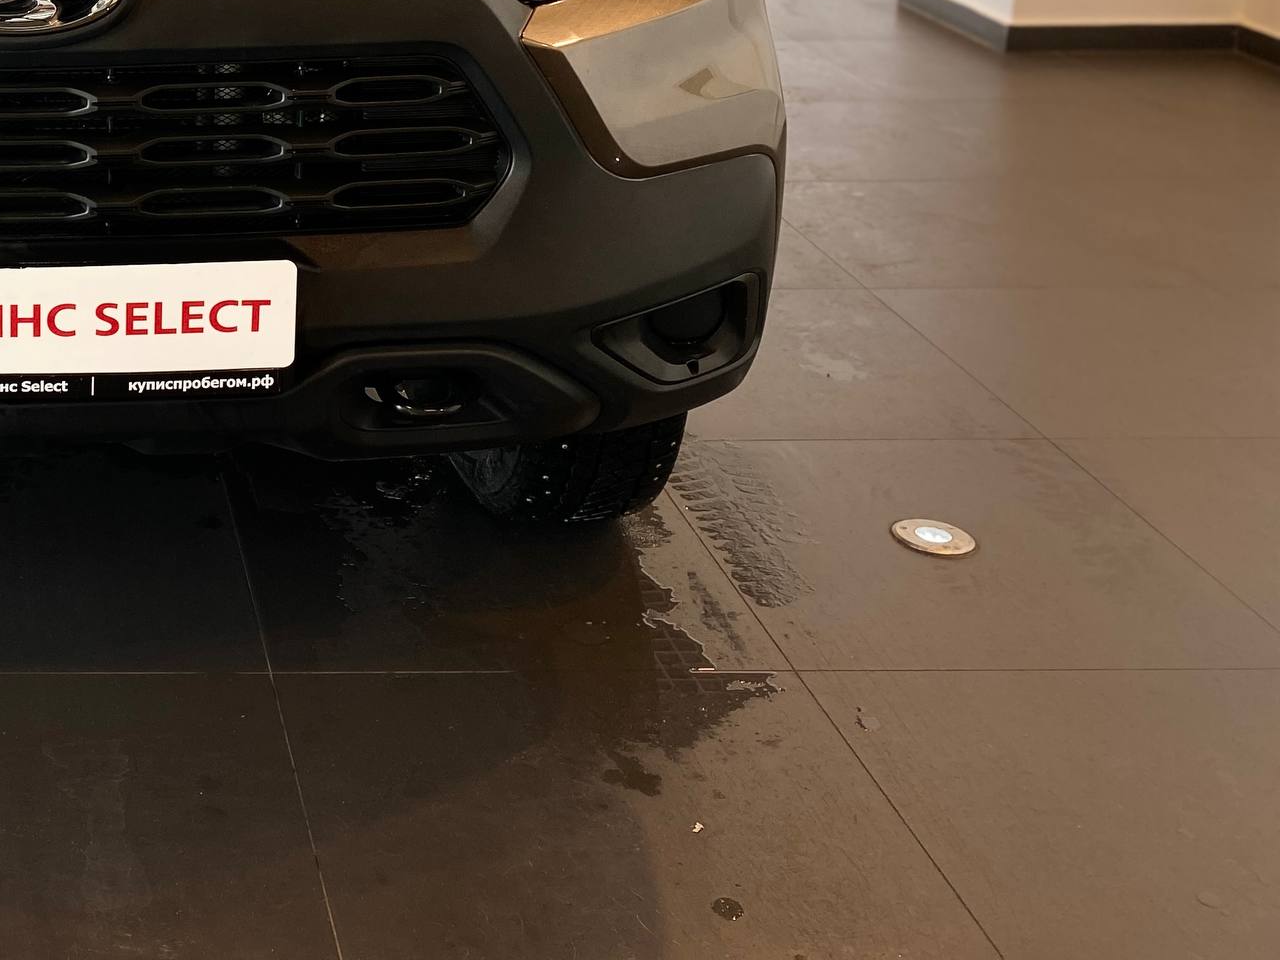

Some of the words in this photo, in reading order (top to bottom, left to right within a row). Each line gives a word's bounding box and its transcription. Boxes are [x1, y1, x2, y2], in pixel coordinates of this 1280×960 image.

[94, 298, 272, 337] SELECT
[21, 379, 69, 393] Select
[128, 374, 275, 393] куписпробегом.рф
